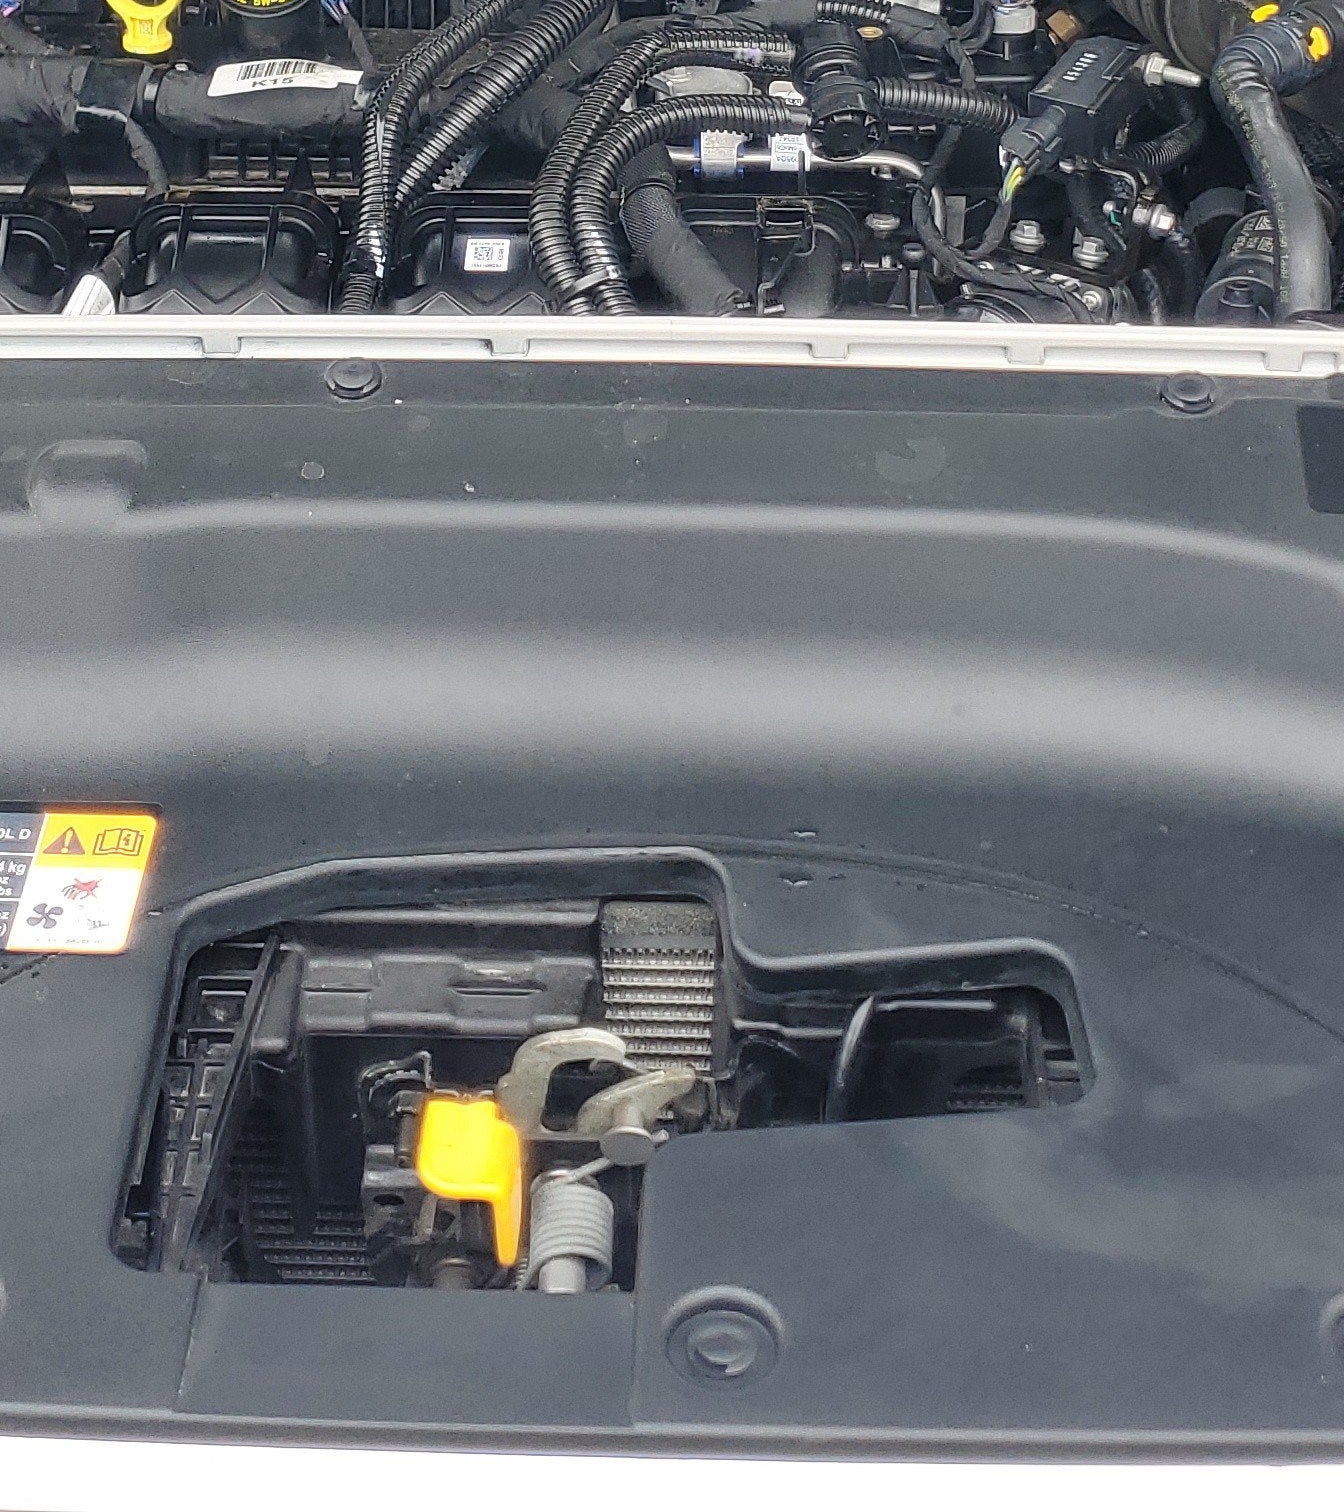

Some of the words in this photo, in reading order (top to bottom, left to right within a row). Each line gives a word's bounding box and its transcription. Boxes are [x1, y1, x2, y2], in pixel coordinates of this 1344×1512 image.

[251, 76, 294, 88] K15
[18, 827, 32, 840] D
[7, 861, 27, 875] kg
